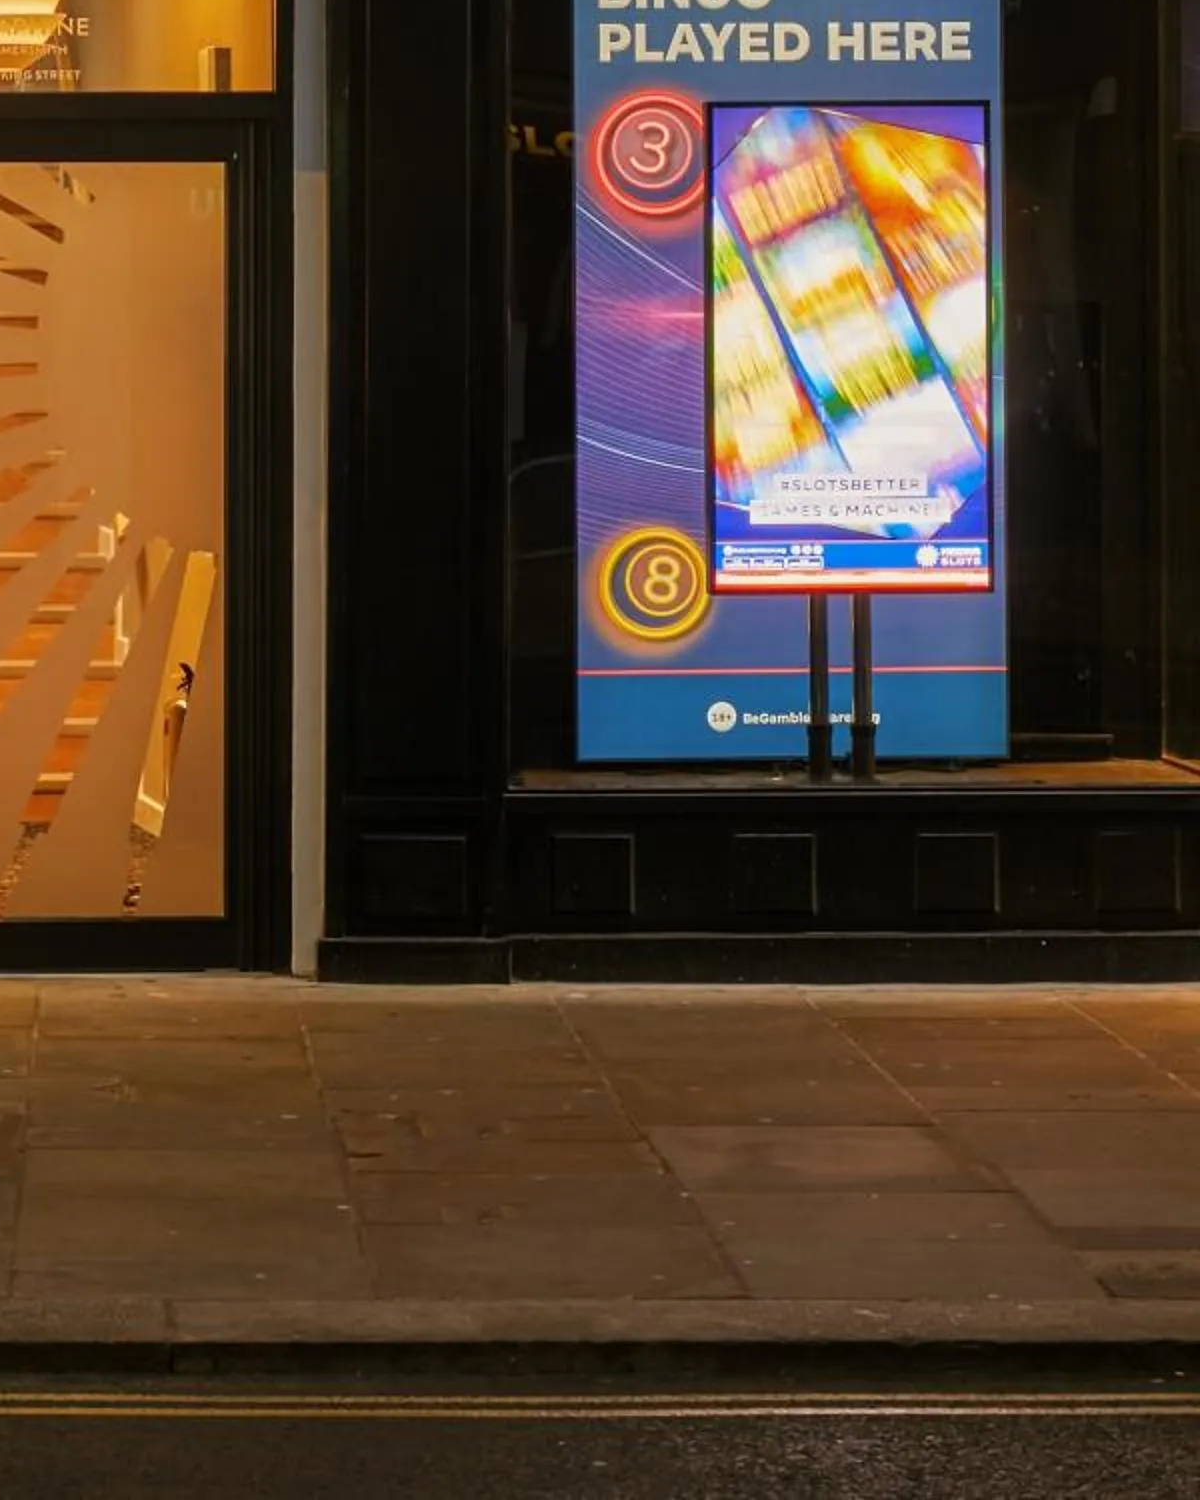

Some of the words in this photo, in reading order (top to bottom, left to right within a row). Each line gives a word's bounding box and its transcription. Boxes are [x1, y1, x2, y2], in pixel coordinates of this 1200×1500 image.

[599, 22, 811, 62] PLAYED
[827, 21, 972, 61] HERE
[629, 121, 670, 174] 3
[781, 479, 920, 491] #SLOTSBETTER
[761, 505, 822, 517] AMES
[845, 505, 945, 517] MACHNE
[644, 555, 680, 604] 8
